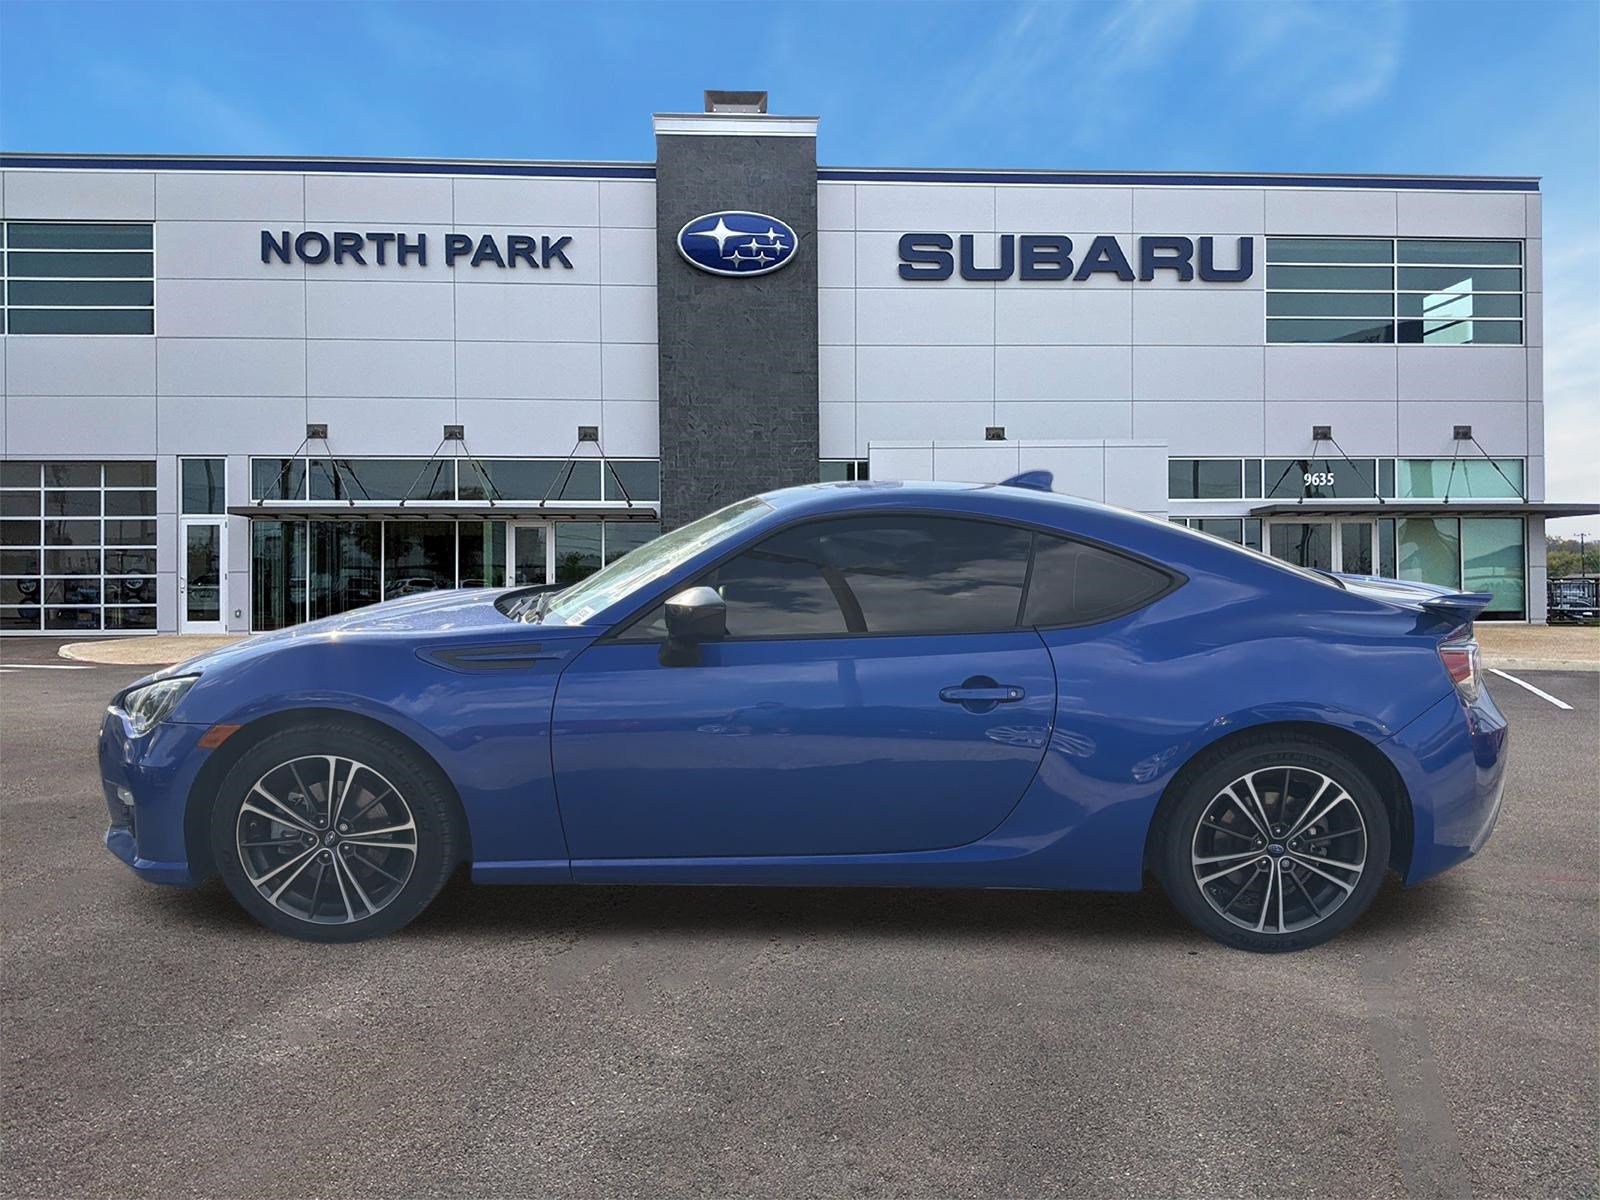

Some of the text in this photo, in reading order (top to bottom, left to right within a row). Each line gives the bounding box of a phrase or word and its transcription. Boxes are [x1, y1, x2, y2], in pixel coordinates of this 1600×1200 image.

[260, 231, 574, 270] NORTH PARK
[898, 232, 1254, 284] SUBARU
[1303, 472, 1335, 486] 9635
